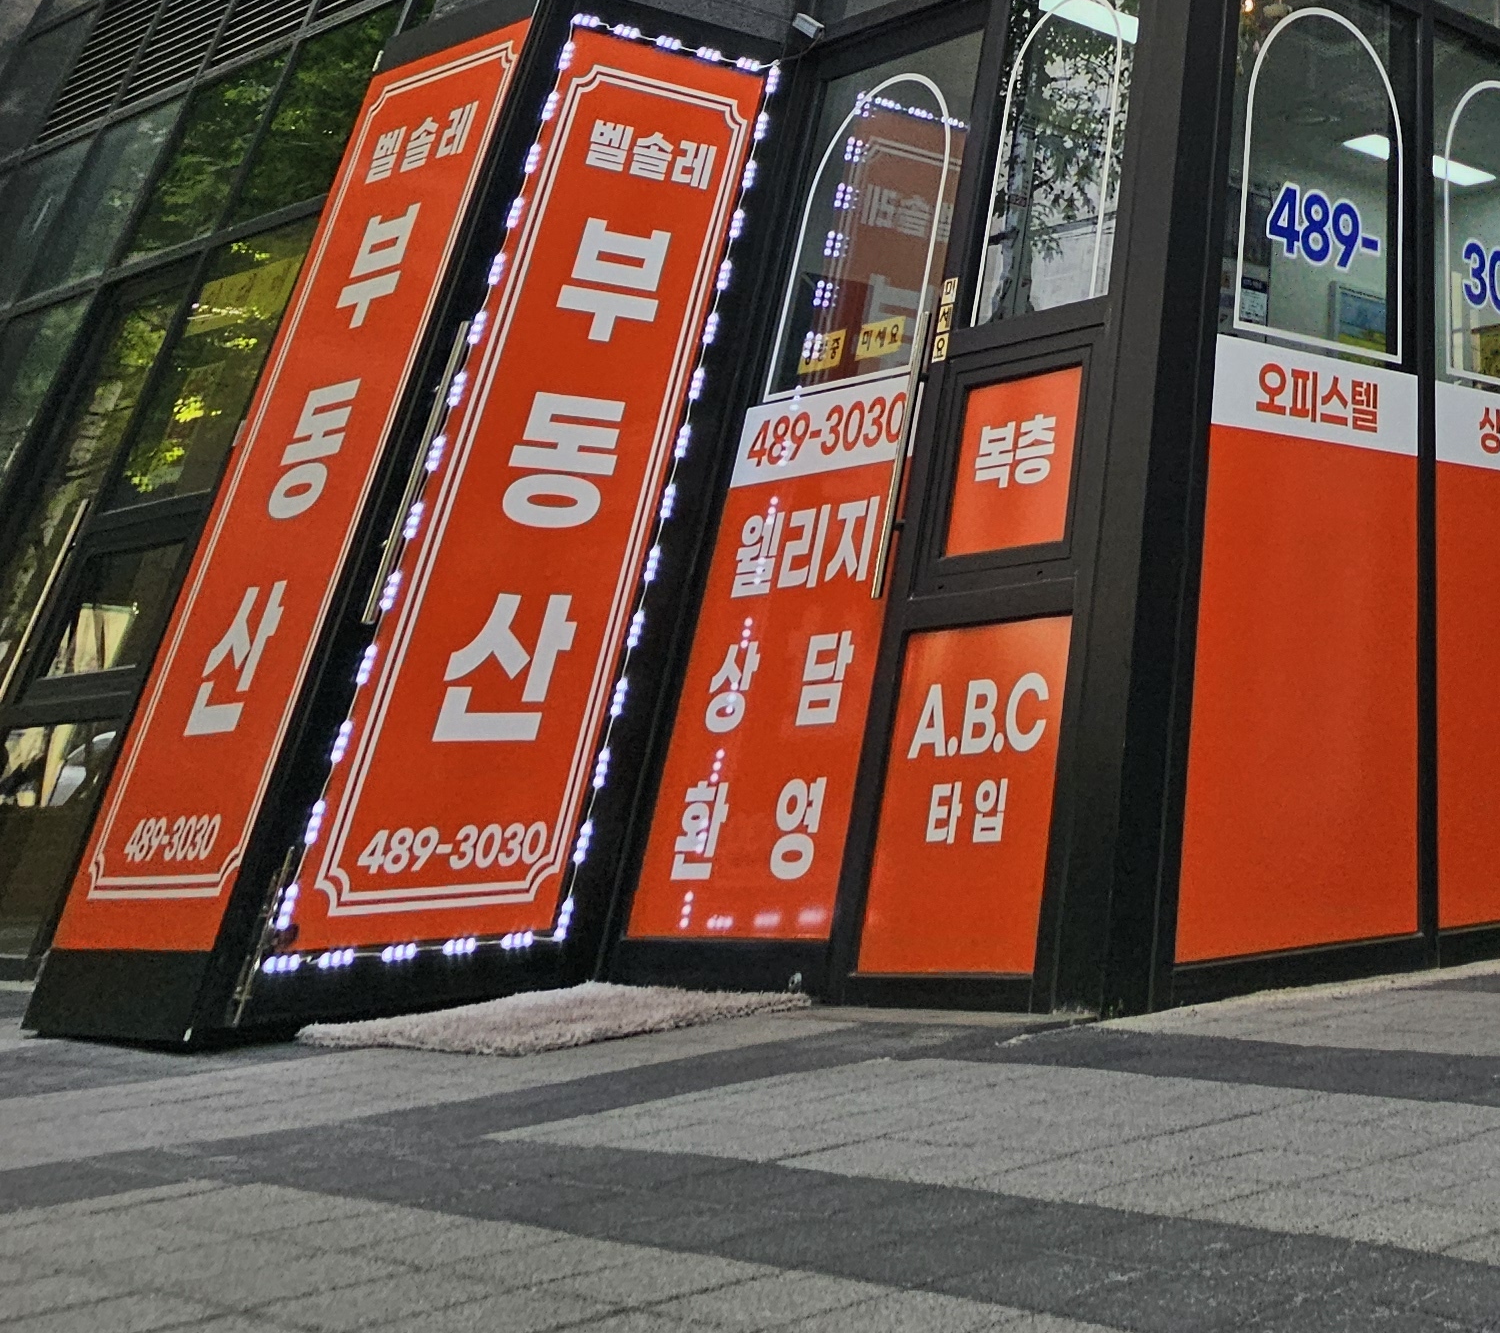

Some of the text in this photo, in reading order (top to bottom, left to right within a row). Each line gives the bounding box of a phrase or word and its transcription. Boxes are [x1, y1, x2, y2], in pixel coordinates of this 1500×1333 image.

[364, 100, 479, 185] 벨솔레
[586, 120, 717, 193] 벨솔레
[747, 391, 907, 468] 489-3030
[1255, 363, 1379, 434] 오피스텔
[973, 414, 1056, 489] 복층
[730, 495, 881, 599] 웰리지
[907, 671, 1048, 760] A.B.C
[123, 812, 222, 864] 489-3030
[356, 819, 548, 872] 489-3030
[925, 778, 1009, 845] 타입
